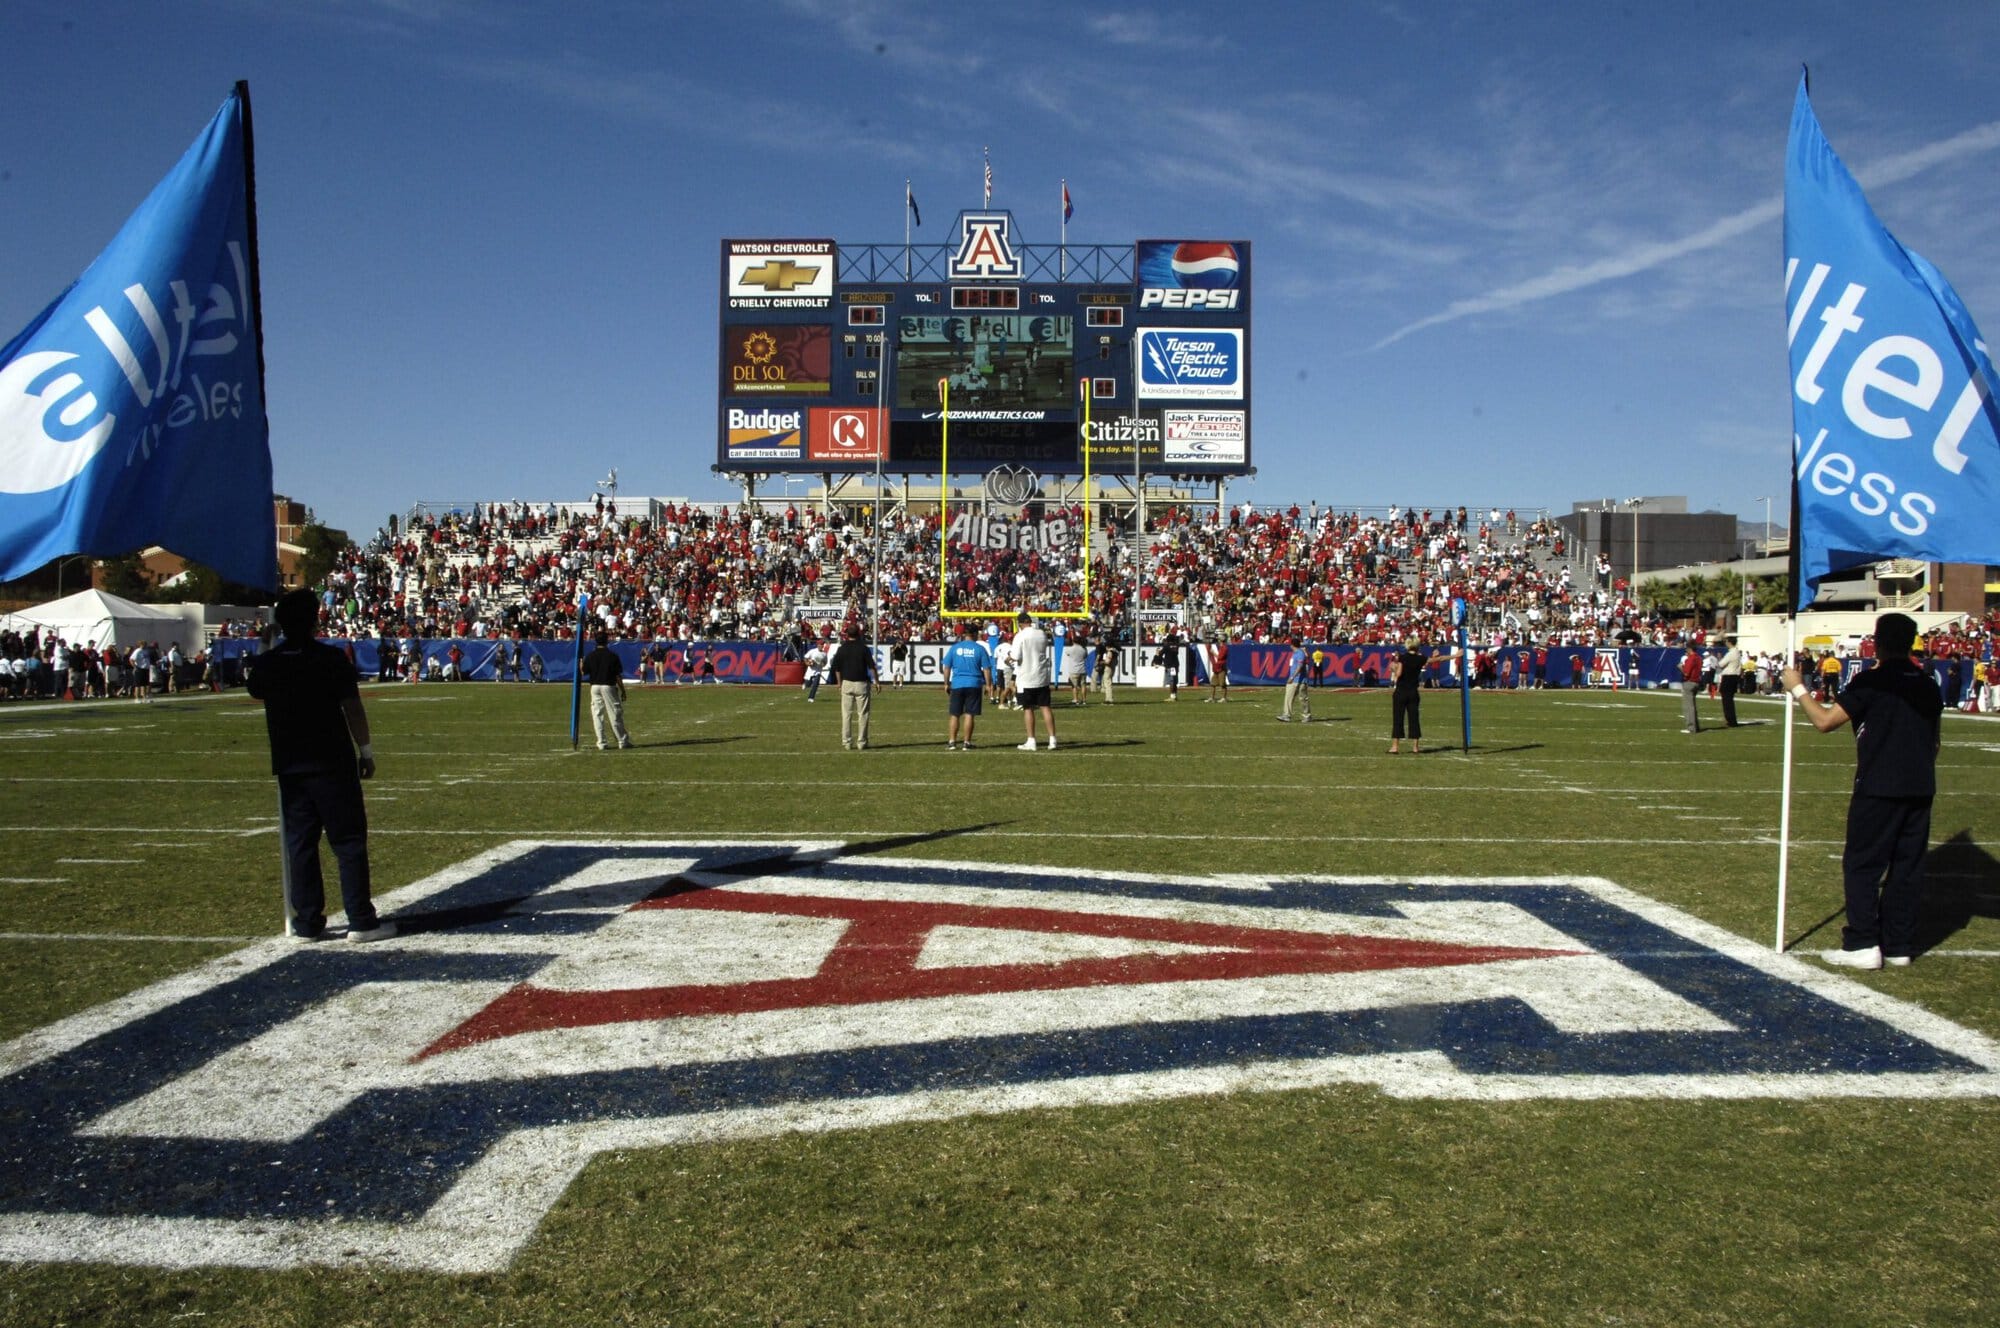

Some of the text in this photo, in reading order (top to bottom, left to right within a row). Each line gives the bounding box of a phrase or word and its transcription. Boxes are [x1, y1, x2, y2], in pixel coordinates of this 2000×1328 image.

[731, 244, 830, 253] WATSON CHEVROLET
[949, 216, 1021, 278] A
[730, 299, 829, 308] O'RIELLY CHEVROLET
[915, 294, 932, 302] TOL
[1039, 295, 1056, 303] TOL
[1140, 288, 1239, 310] PEPSI
[1166, 338, 1215, 352] Tucson
[1171, 352, 1229, 365] Electric
[734, 366, 786, 380] DEL SOL
[1177, 365, 1228, 378] Power
[1183, 388, 1205, 396] Energy
[1207, 388, 1237, 396] Company
[729, 409, 800, 435] Budget
[1119, 416, 1158, 426] Tucson
[1169, 414, 1241, 422] Jack Furrier's
[837, 416, 864, 446] K
[1081, 421, 1160, 441] Citizen
[1168, 422, 1241, 438] WESTERN
[1794, 427, 1937, 536] less
[946, 512, 1069, 550] Allstate
